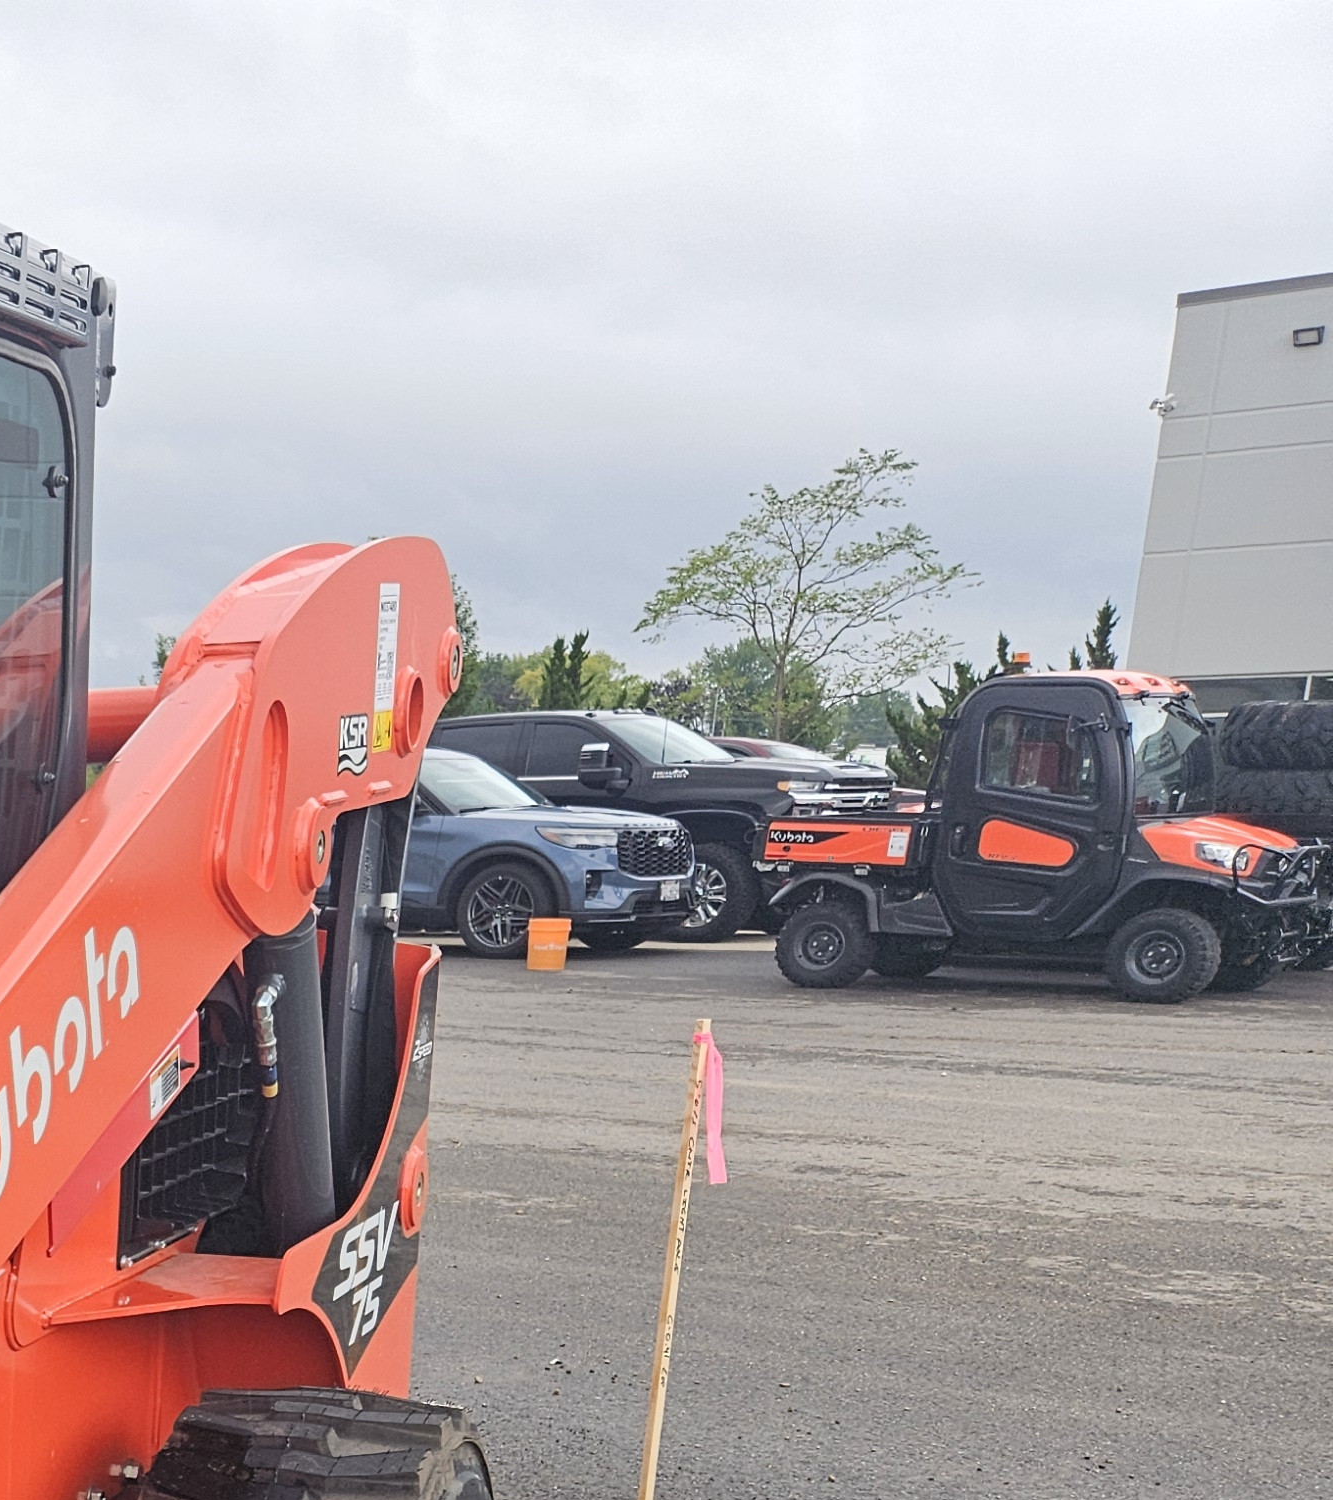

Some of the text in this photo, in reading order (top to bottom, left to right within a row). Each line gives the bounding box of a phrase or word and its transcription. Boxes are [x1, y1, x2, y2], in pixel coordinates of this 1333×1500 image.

[339, 714, 368, 749] KSR
[770, 830, 814, 843] Kubota
[333, 1200, 400, 1301] SSV
[348, 1274, 383, 1347] 75
